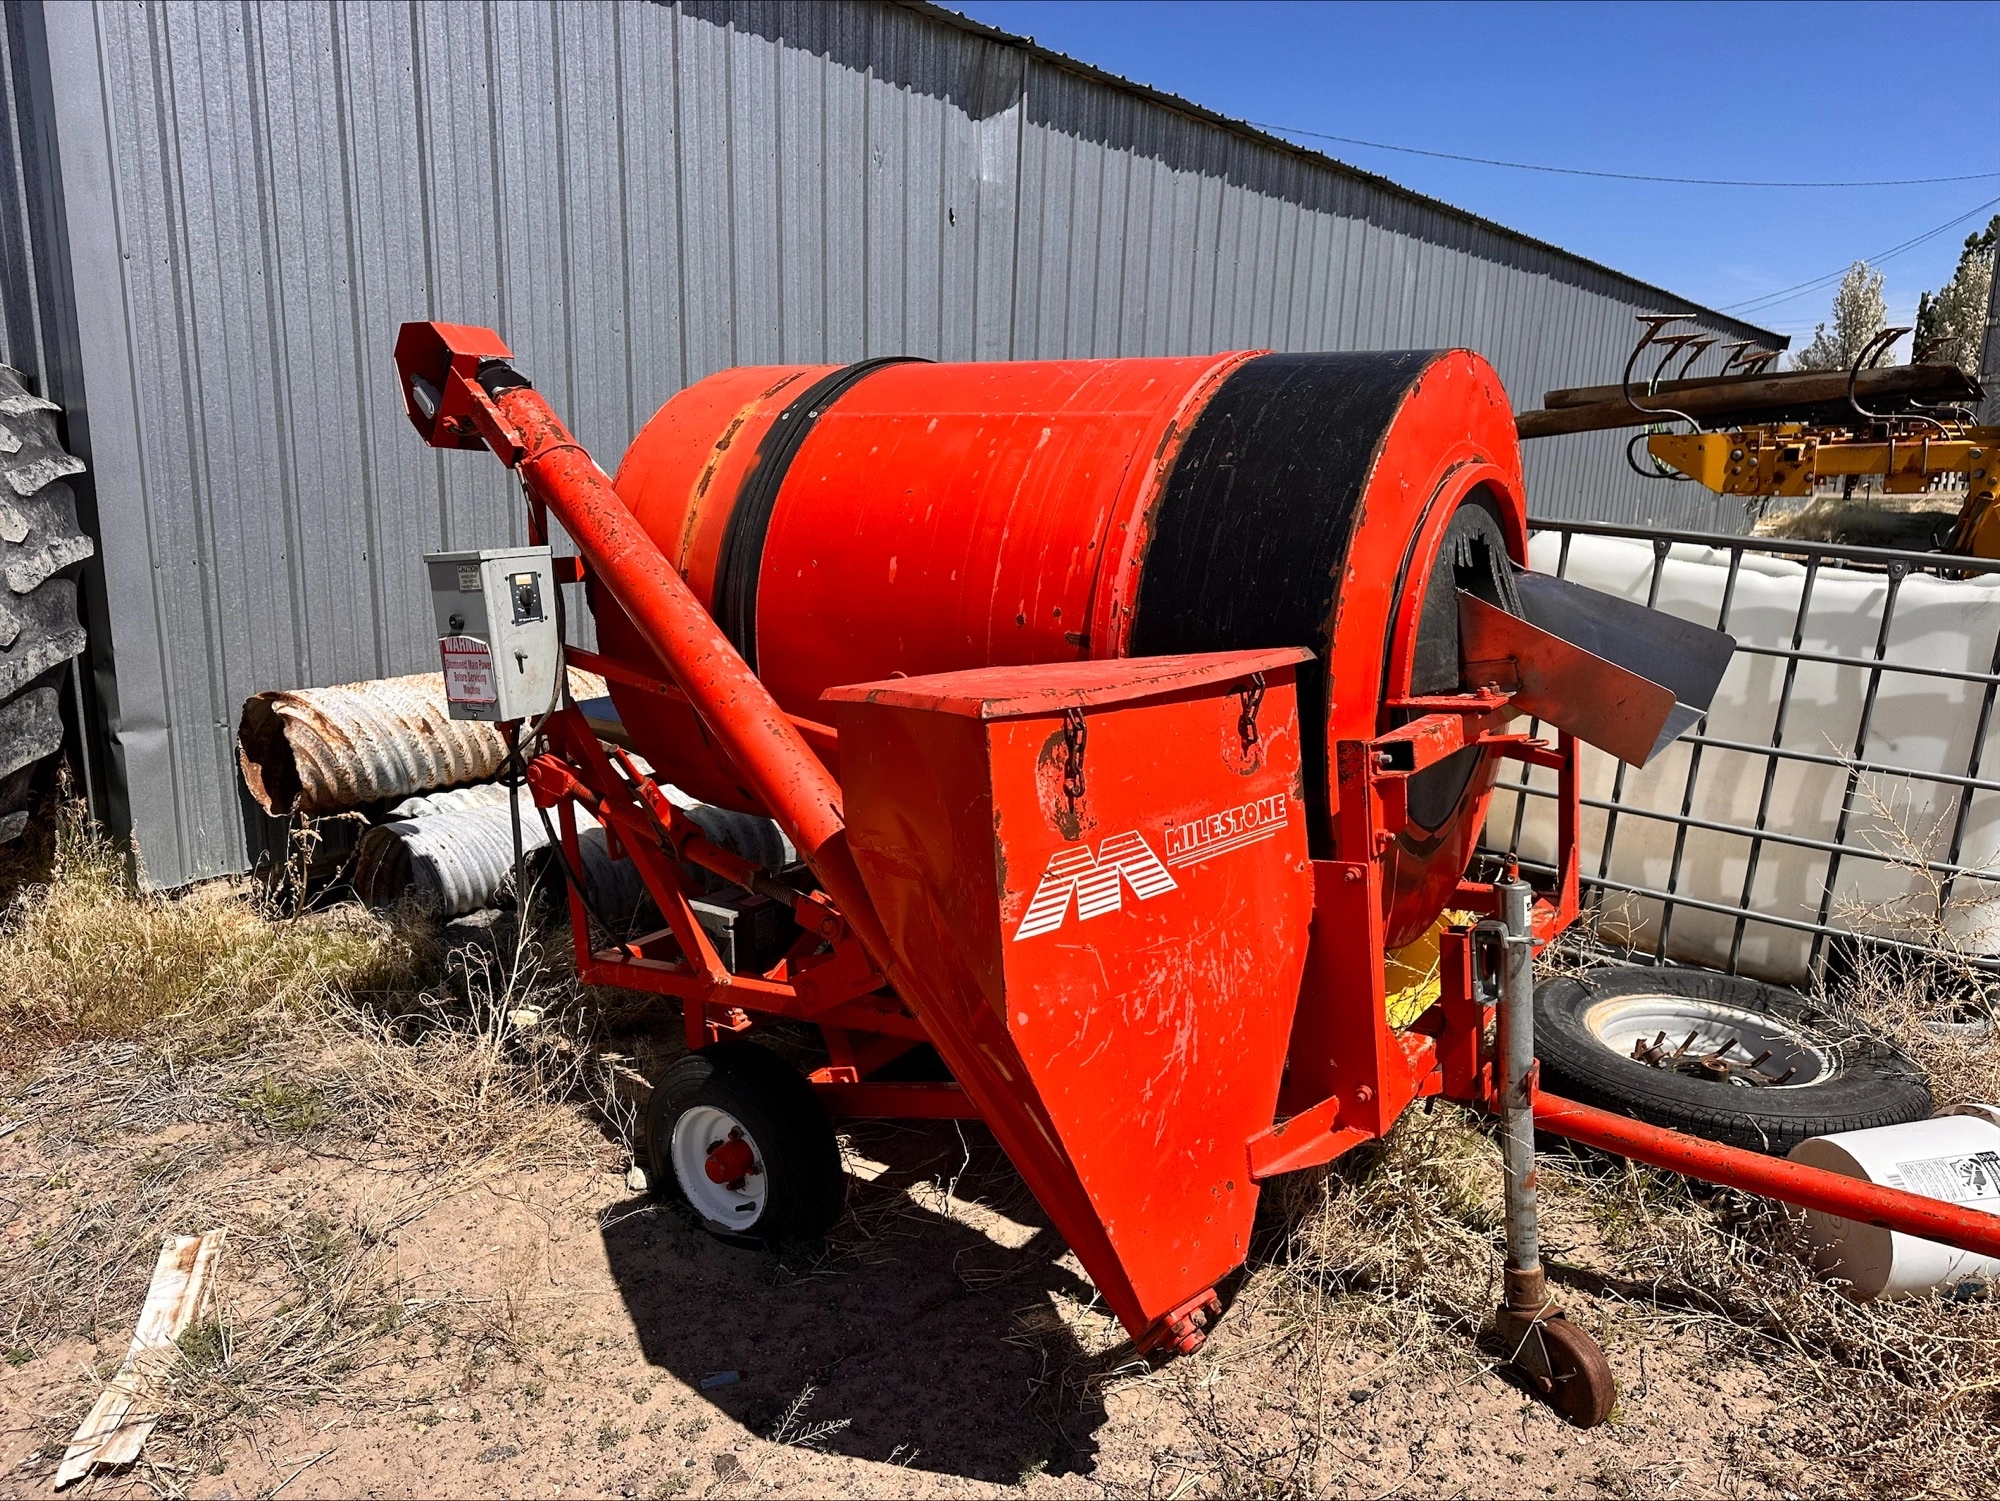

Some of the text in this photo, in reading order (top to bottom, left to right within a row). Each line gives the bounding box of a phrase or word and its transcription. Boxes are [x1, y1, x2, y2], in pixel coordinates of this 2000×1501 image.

[468, 659, 478, 670] Main
[454, 671, 467, 682] Before
[1164, 793, 1287, 857] MILESTONE
